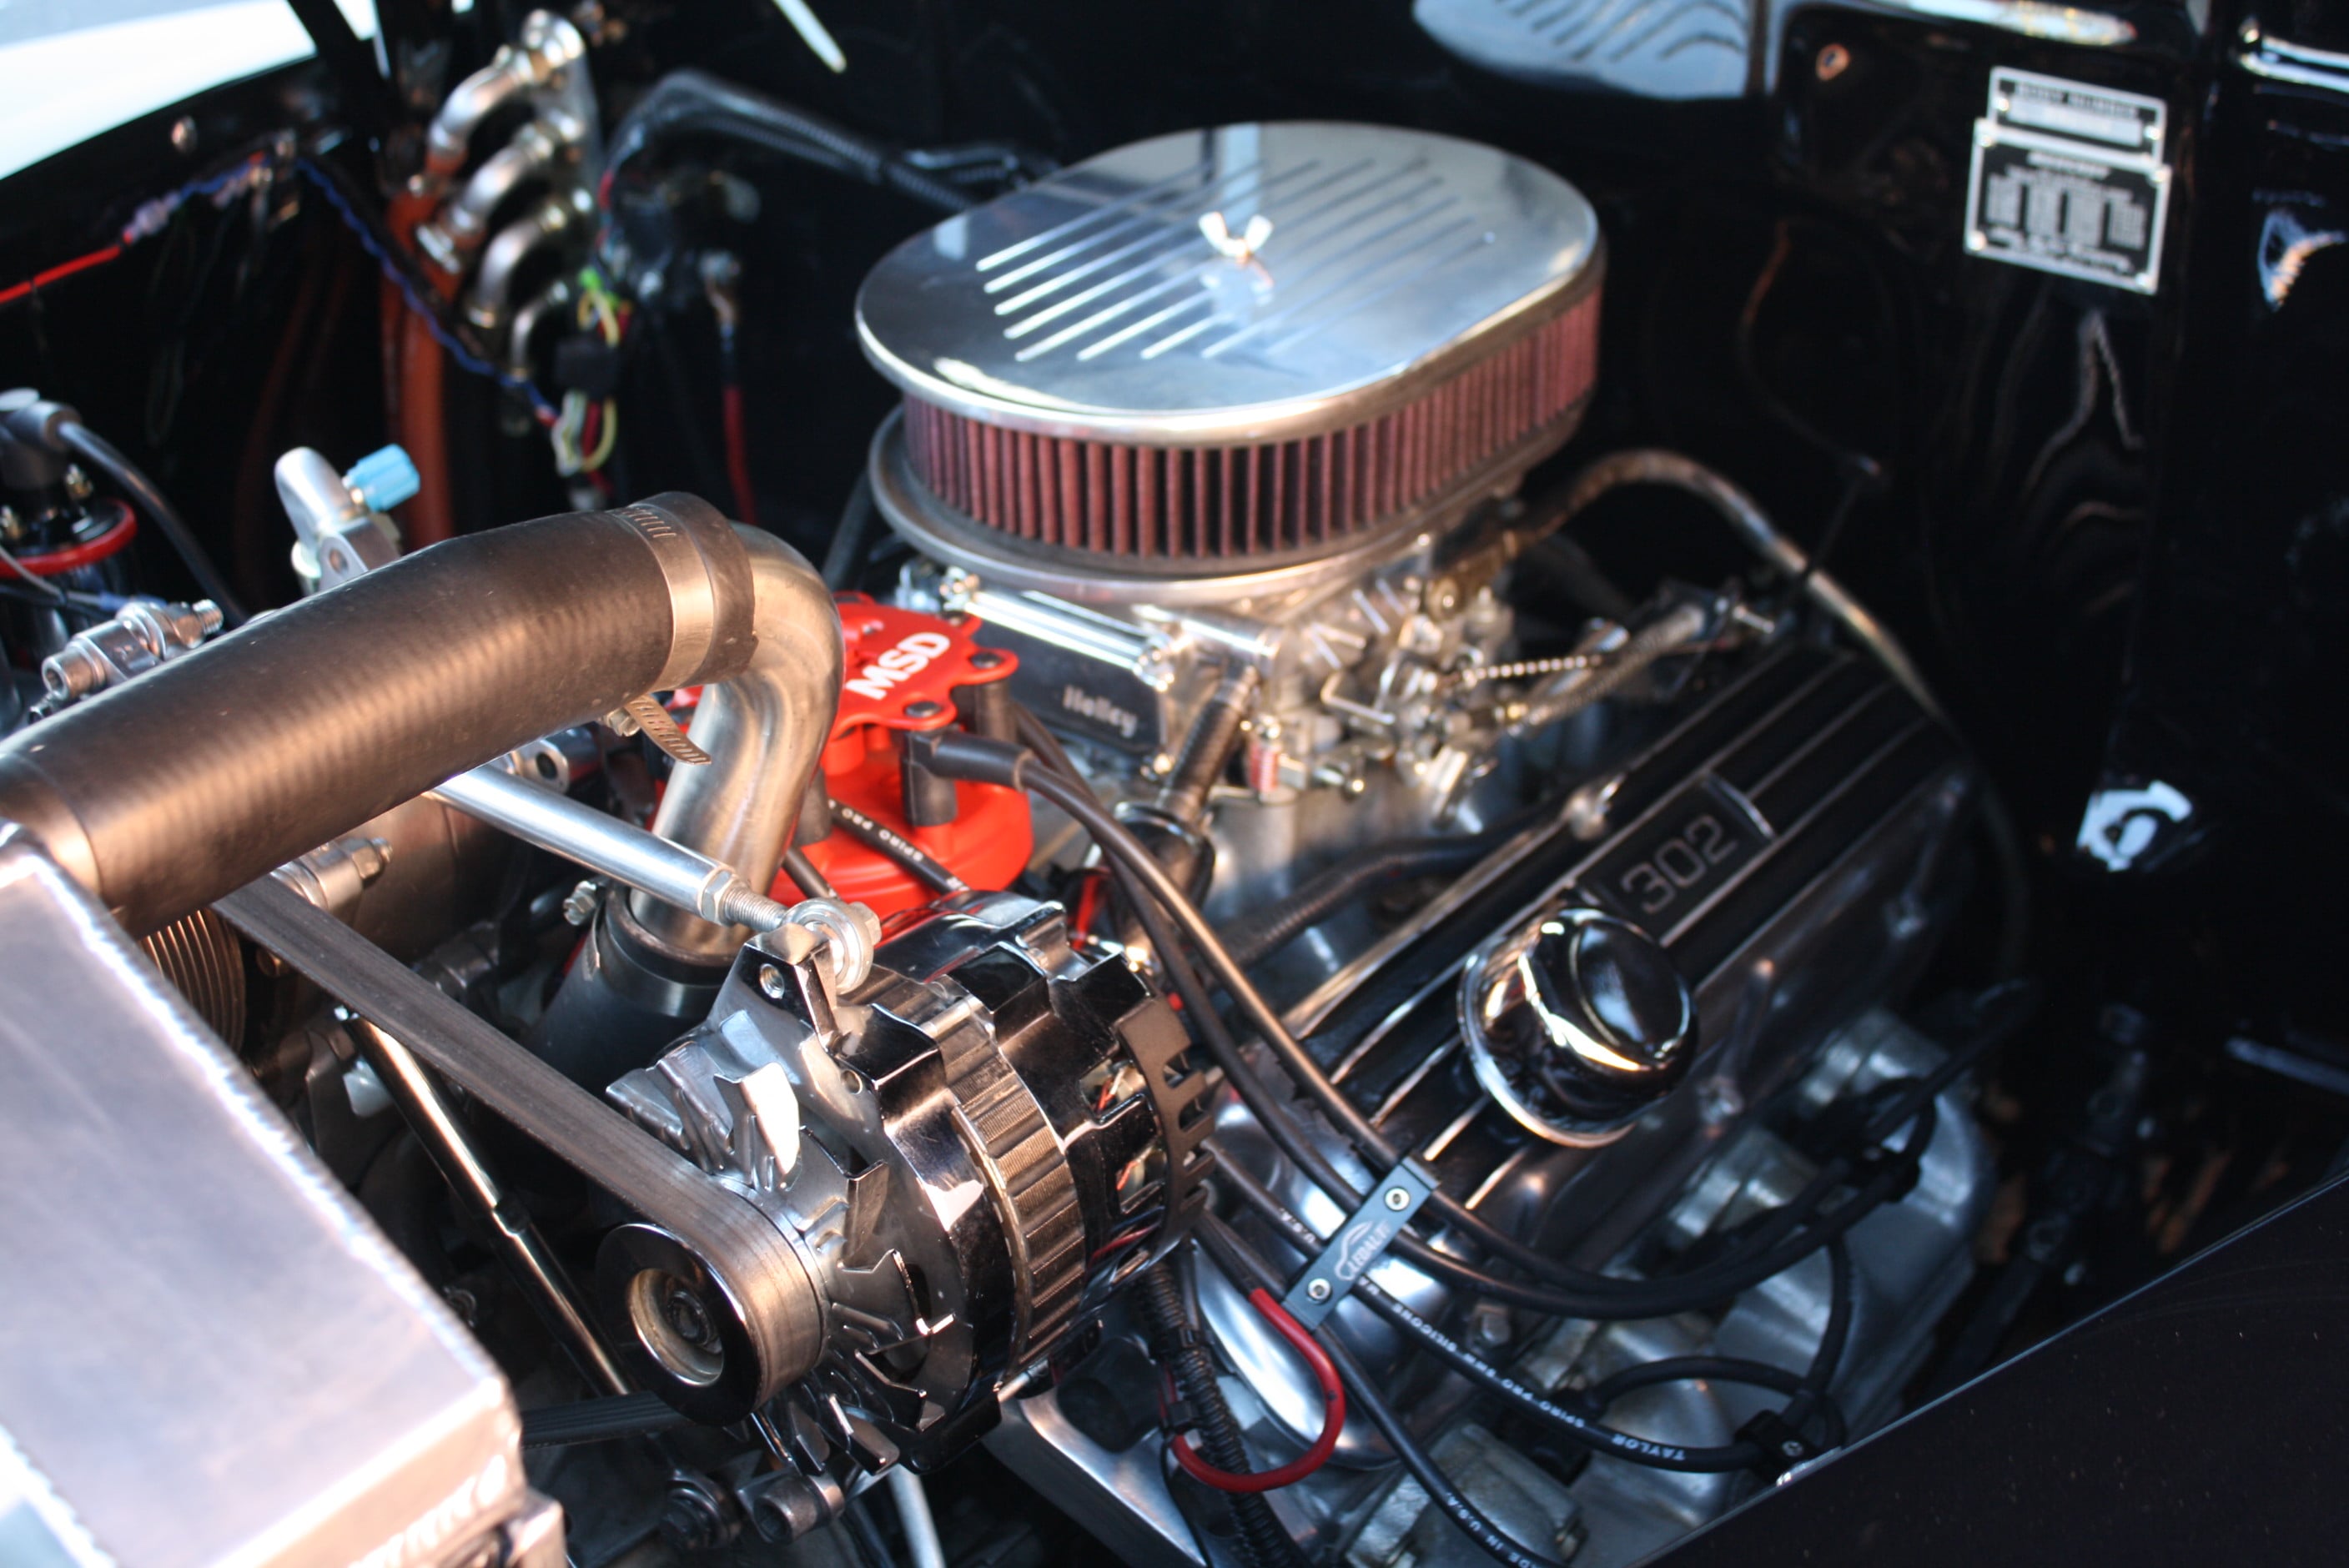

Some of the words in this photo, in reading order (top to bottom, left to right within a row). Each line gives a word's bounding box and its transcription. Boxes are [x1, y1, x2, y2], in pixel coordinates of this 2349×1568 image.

[845, 631, 951, 700] MSD
[841, 807, 873, 832] PRO
[878, 828, 923, 862] SPIRO
[1621, 814, 1740, 914] 302
[1392, 1302, 1459, 1353] SILICONE
[1501, 1376, 1534, 1403] PRO
[1539, 1399, 1585, 1430] SPIRO
[1611, 1432, 1686, 1462] TAYLOR
[1446, 1491, 1481, 1531] U.S.A.
[1486, 1534, 1504, 1551] IN
